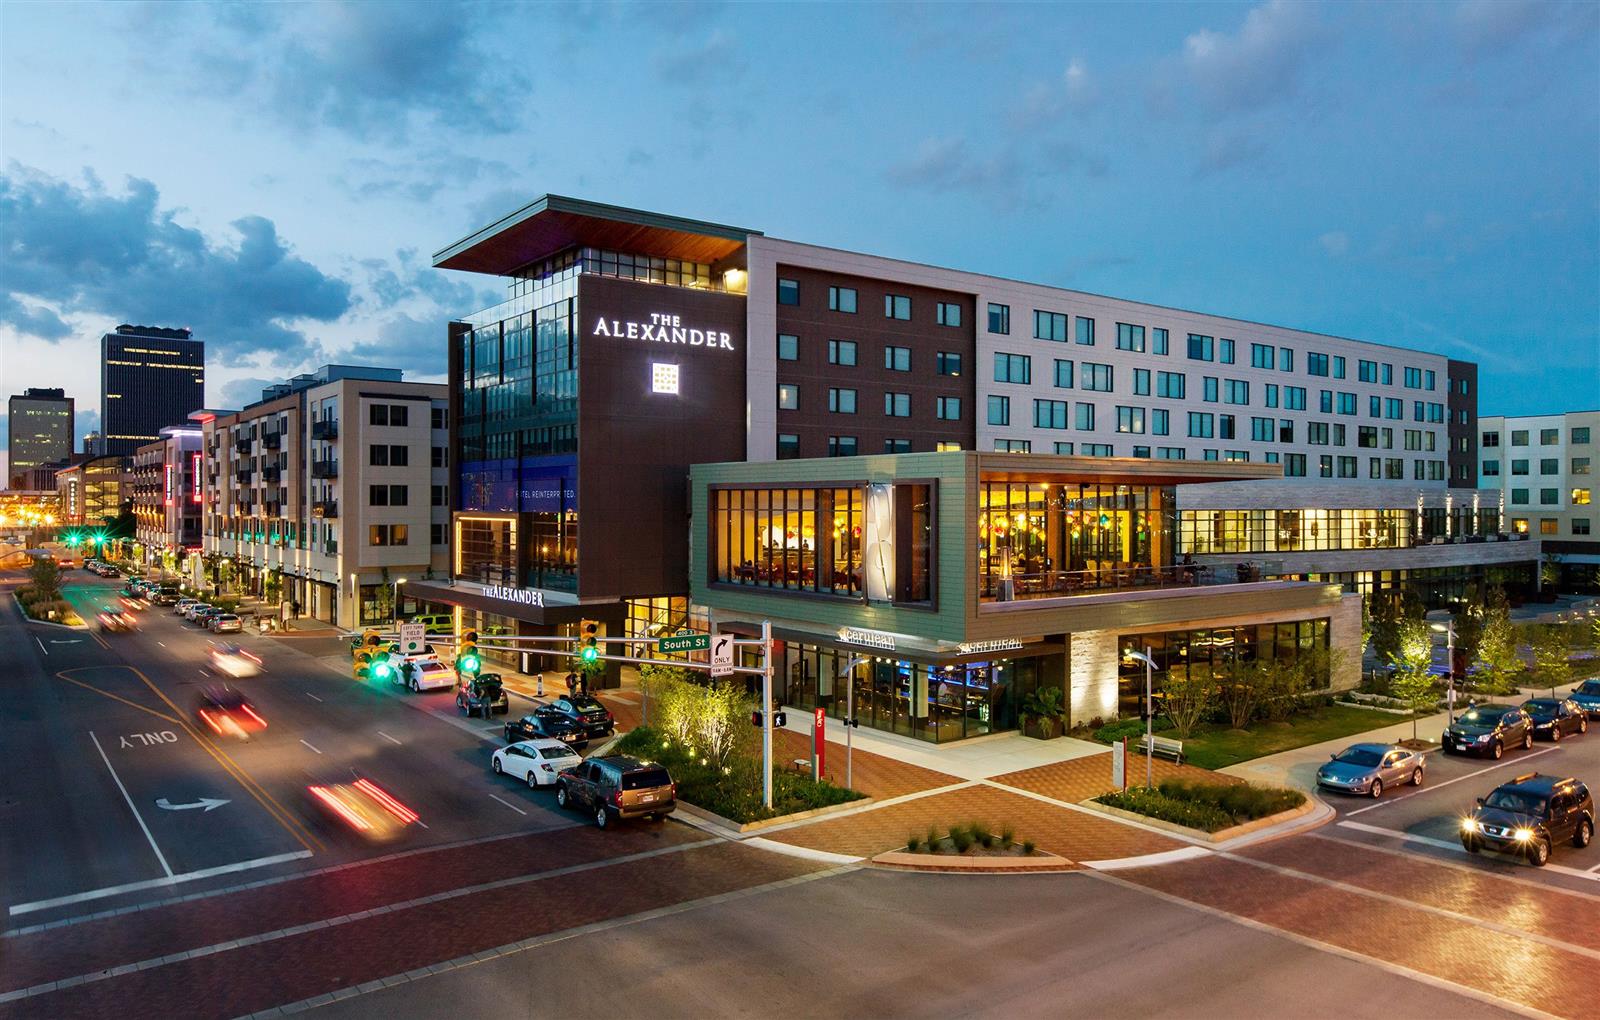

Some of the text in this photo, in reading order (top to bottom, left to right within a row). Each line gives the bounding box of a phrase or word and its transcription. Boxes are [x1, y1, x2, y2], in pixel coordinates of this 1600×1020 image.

[651, 313, 680, 327] THE
[593, 317, 734, 350] ALEXANDER
[532, 490, 576, 499] REINTERPRTED.
[493, 584, 544, 608] ALEXANDER
[664, 638, 706, 649] South St
[847, 630, 895, 645] cerulean
[715, 656, 730, 664] ONLY
[120, 731, 178, 749] ONLY
